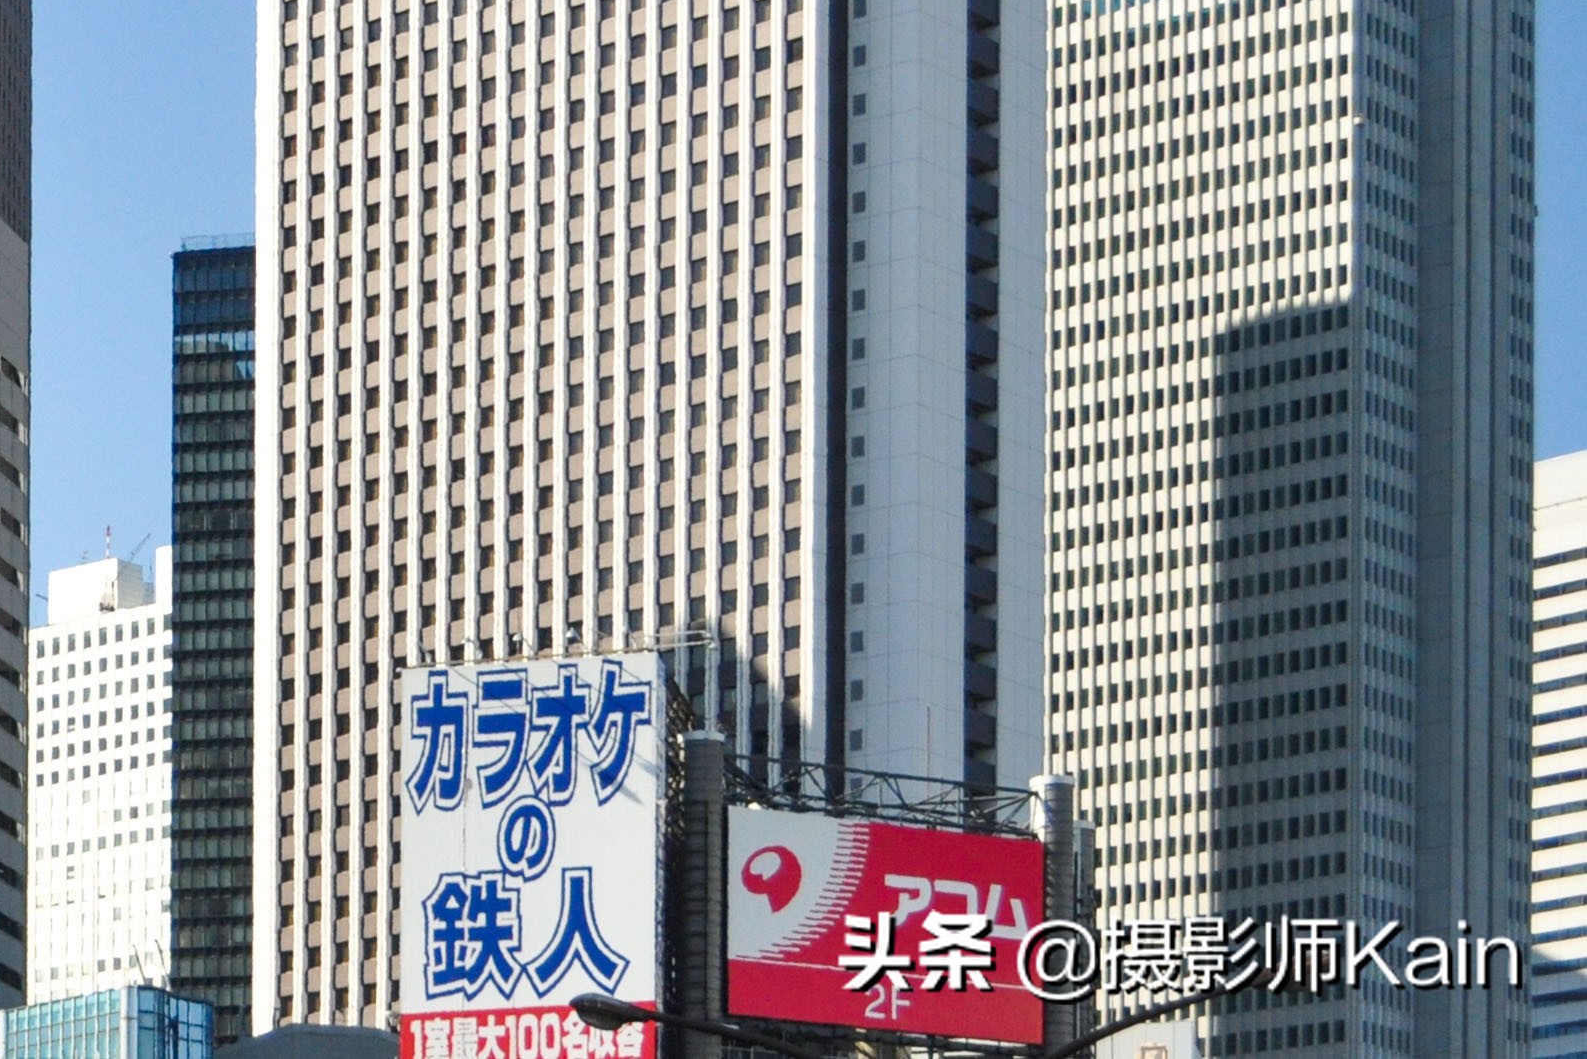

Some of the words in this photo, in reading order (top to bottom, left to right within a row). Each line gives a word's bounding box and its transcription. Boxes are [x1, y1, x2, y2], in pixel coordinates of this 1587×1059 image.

[408, 662, 651, 812] カラオケ
[499, 798, 554, 880] の
[424, 868, 630, 999] 鉄人
[864, 984, 911, 1020] 2F
